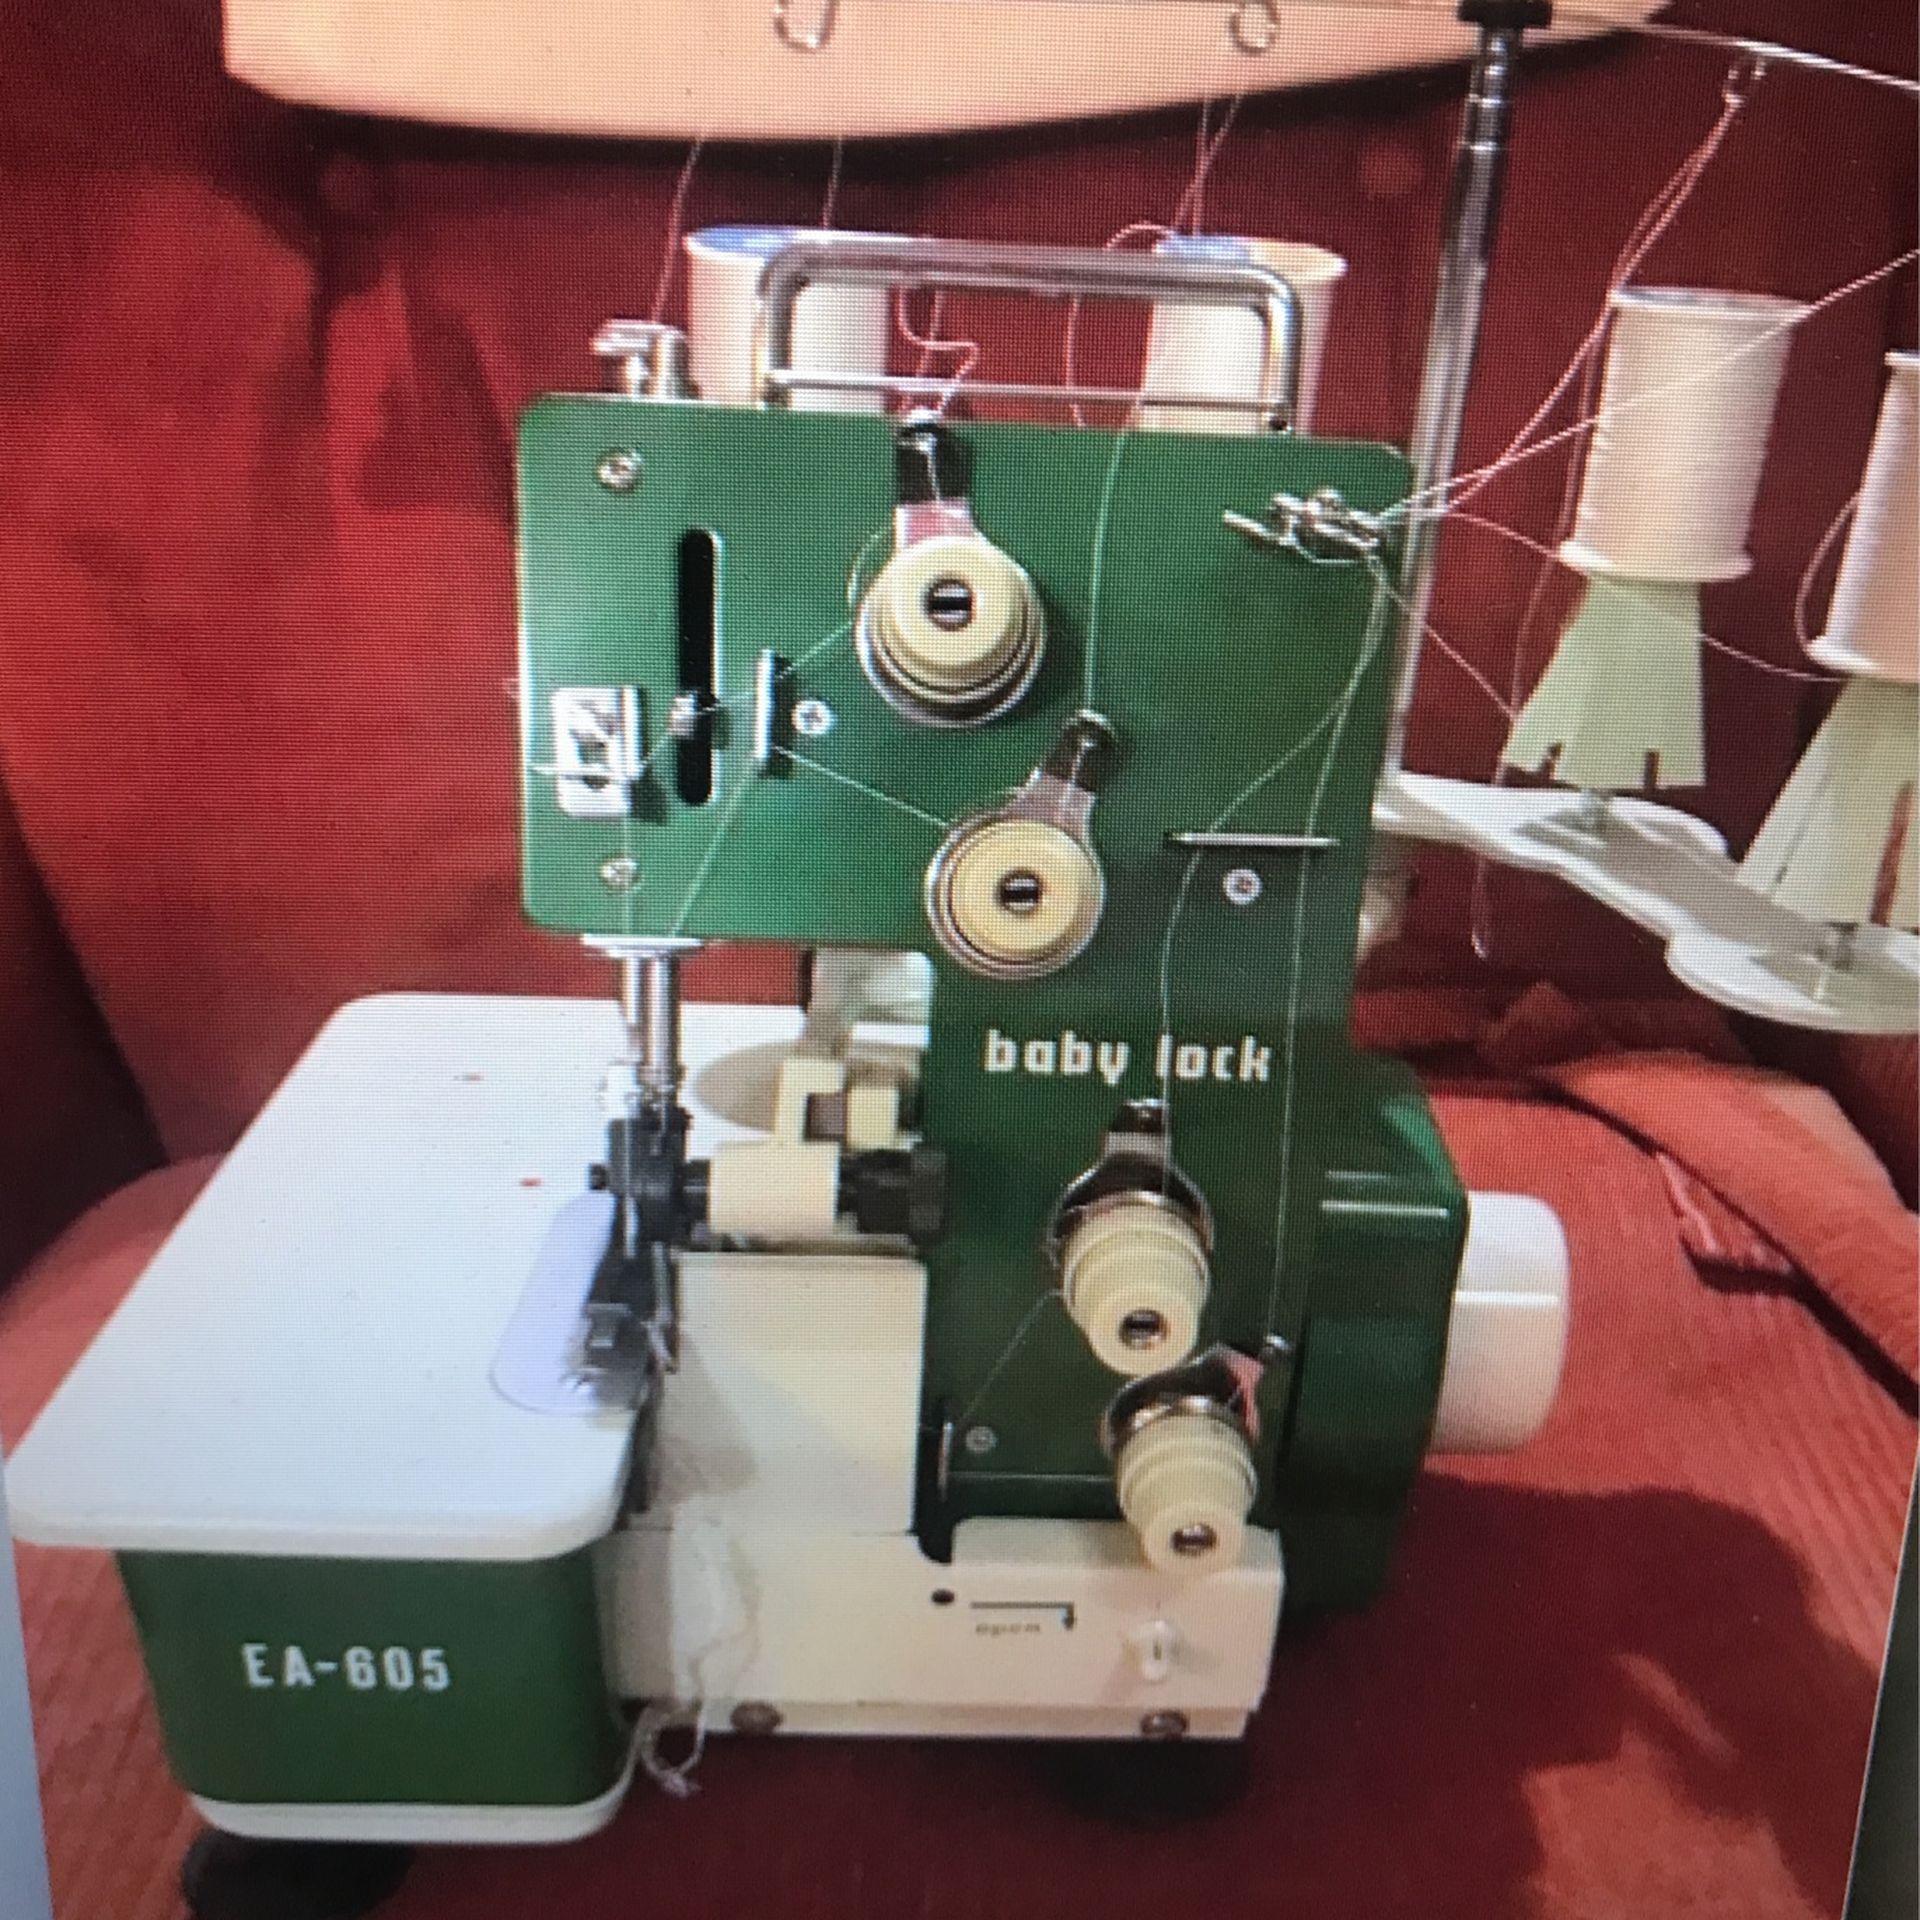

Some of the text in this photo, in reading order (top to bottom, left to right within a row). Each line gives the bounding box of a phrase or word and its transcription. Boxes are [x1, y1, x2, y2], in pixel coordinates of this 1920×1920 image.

[984, 1029, 1271, 1086] baby lock
[242, 1642, 450, 1691] EA-605
